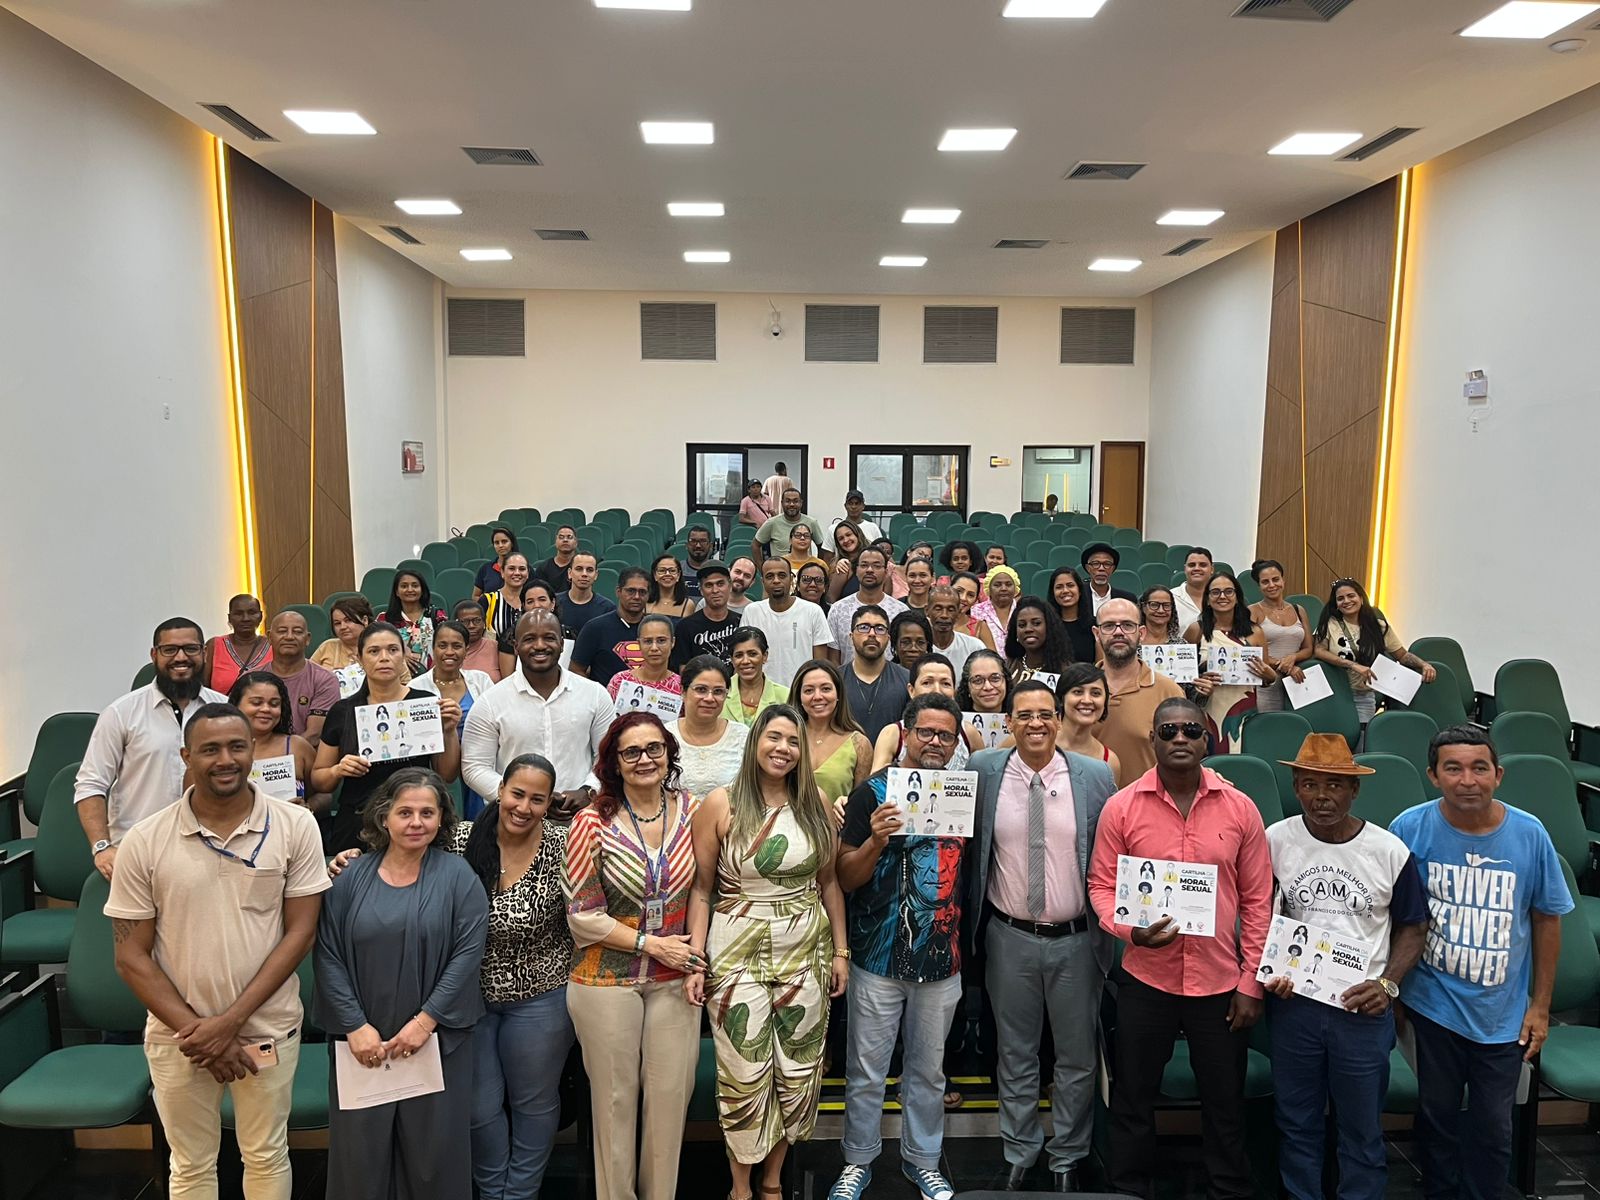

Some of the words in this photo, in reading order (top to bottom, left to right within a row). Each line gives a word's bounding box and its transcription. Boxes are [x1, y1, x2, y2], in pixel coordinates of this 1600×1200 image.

[694, 624, 737, 645] Nauti
[412, 714, 438, 722] SEXUAL
[262, 768, 287, 776] MORAL
[265, 773, 291, 781] SEXUAL
[1180, 878, 1208, 886] MORAL
[1181, 885, 1212, 893] SEXUAL
[1288, 885, 1296, 909] CLUBE
[1294, 866, 1320, 886] AMIGOS
[1322, 865, 1334, 873] DA
[1336, 867, 1369, 895] MELHOR
[1428, 861, 1516, 910] REVIVER
[1428, 897, 1513, 949] REVIVER
[1335, 941, 1360, 953] CARTILHA
[1331, 949, 1361, 964] MORAL
[1332, 956, 1364, 972] SEXUAL
[1423, 930, 1509, 987] REVIVER
